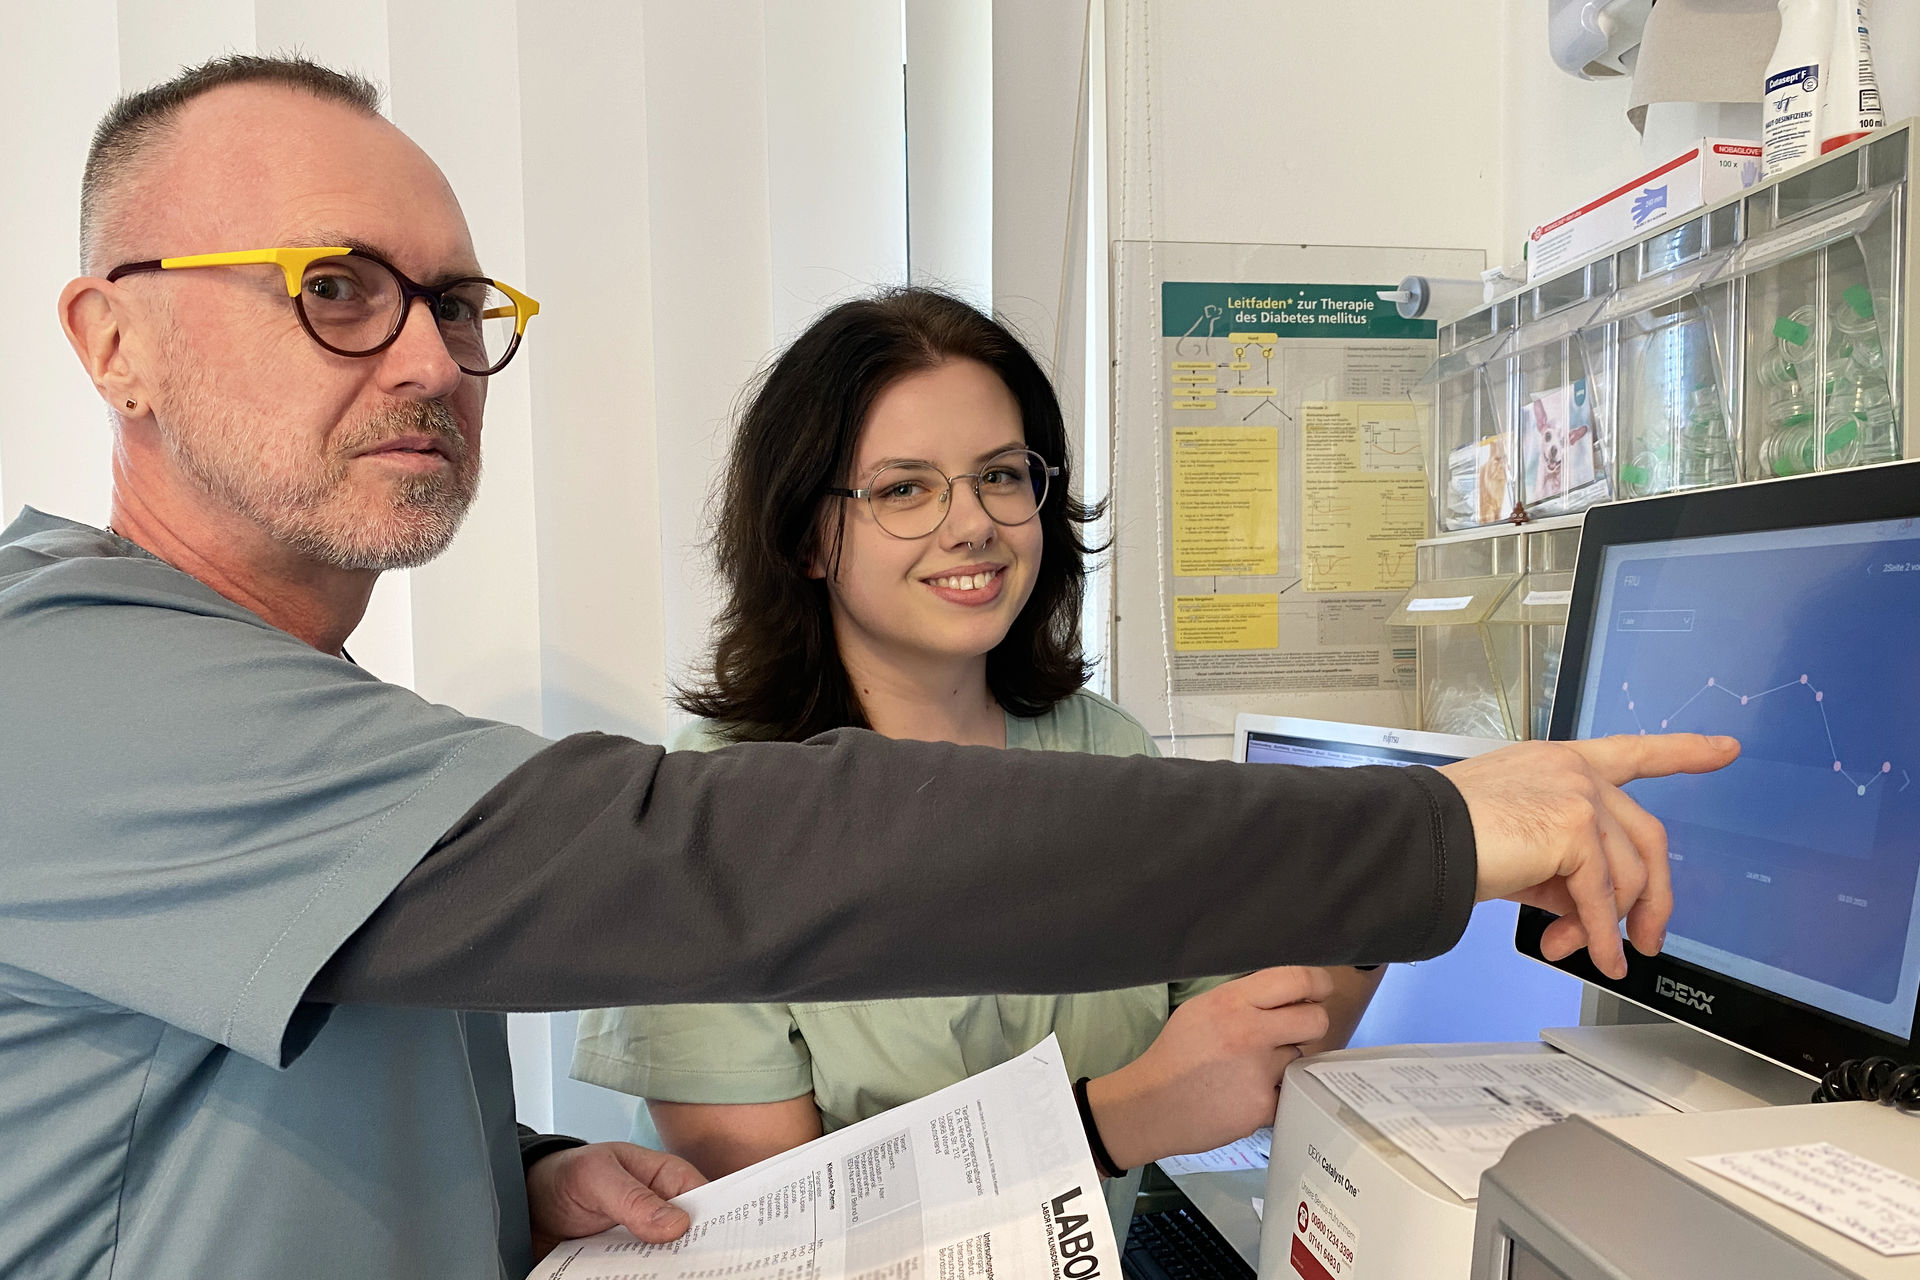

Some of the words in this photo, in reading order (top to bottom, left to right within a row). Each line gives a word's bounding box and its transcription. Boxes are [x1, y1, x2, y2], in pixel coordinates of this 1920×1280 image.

[1801, 70, 1807, 80] F
[1859, 119, 1874, 128] 100
[1718, 146, 1760, 155] NOBAGLOVE
[1719, 160, 1731, 168] 100
[1297, 300, 1317, 310] zur
[1320, 299, 1374, 313] Therapie
[1235, 311, 1257, 323] des
[1260, 312, 1315, 324] Diabetes
[1318, 312, 1367, 325] mellitus
[1655, 975, 1715, 1015] IDEXX
[930, 1120, 941, 1155] Deutschland
[952, 1147, 960, 1160] 212
[826, 1161, 834, 1189] Klinische
[1322, 1158, 1344, 1186] Catalyst
[1041, 1202, 1050, 1224] LABOR
[1046, 1224, 1054, 1236] FÜR
[1311, 1212, 1326, 1235] 00800
[1327, 1228, 1340, 1249] 1234
[1339, 1242, 1354, 1263] 3399
[1048, 1237, 1059, 1267] KLINISCHE
[1309, 1232, 1323, 1255] 07141
